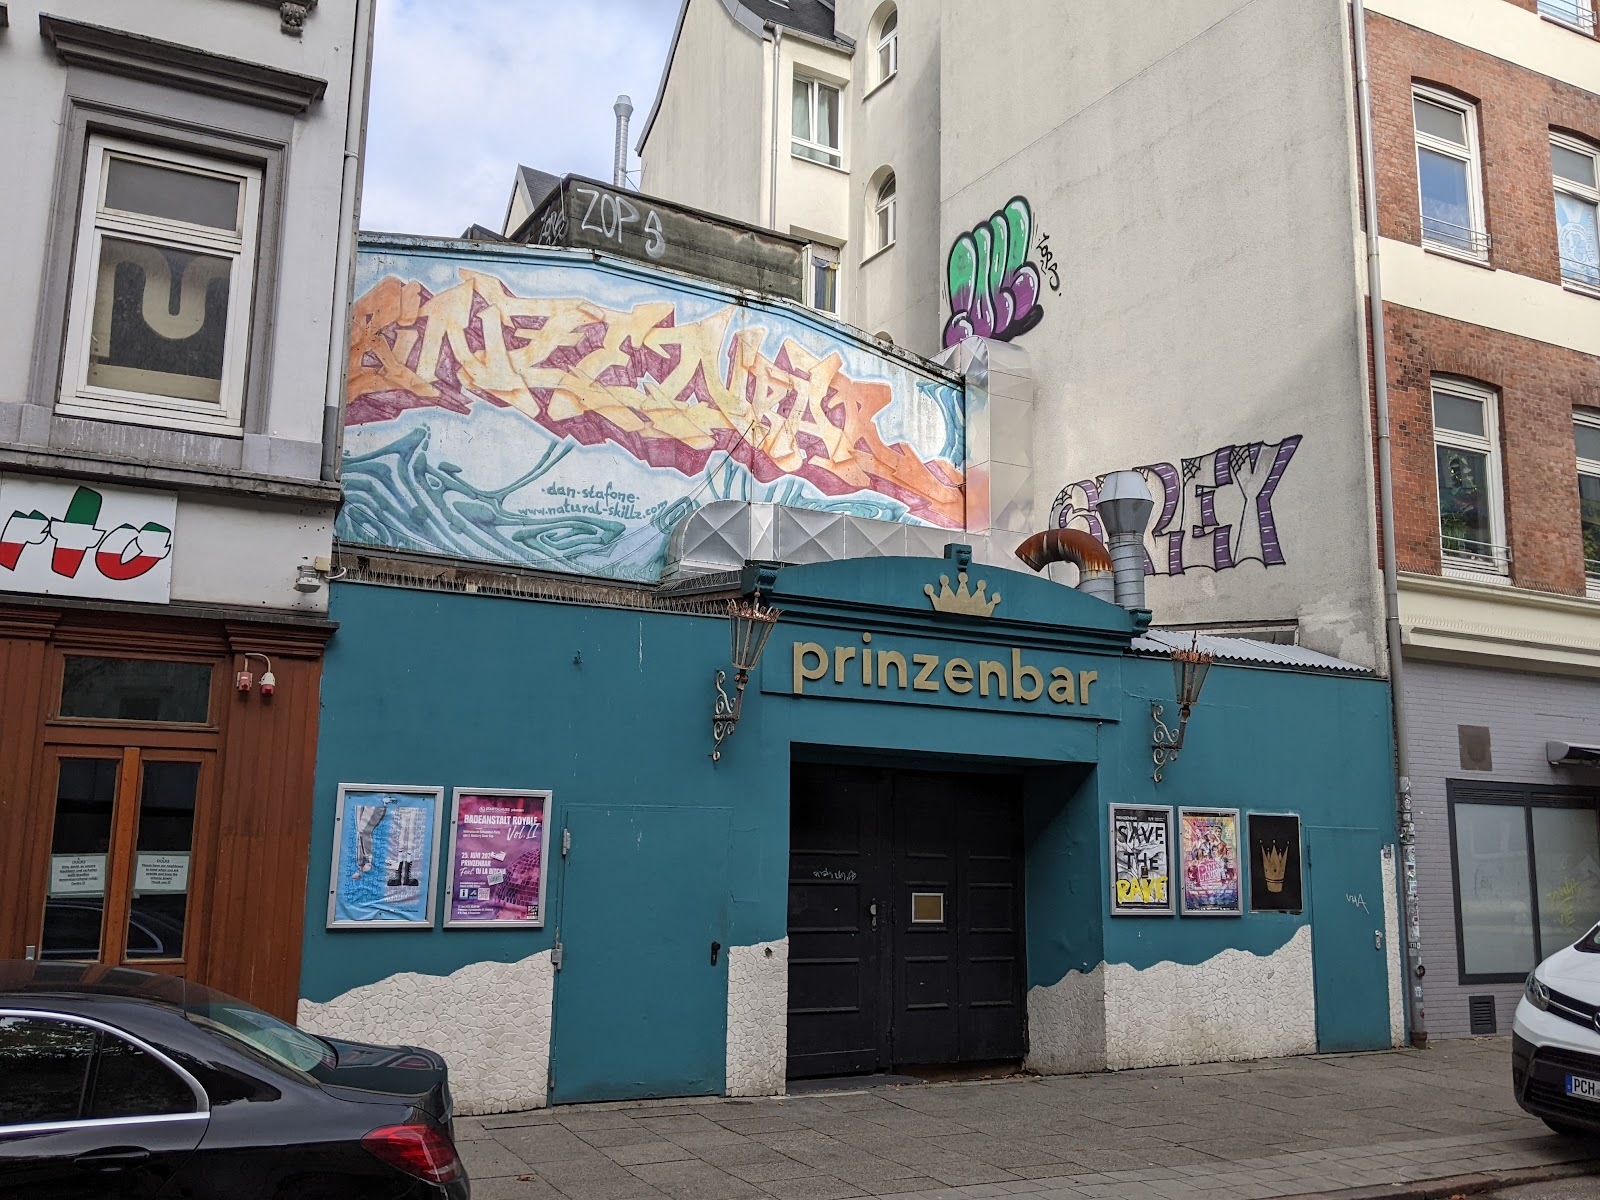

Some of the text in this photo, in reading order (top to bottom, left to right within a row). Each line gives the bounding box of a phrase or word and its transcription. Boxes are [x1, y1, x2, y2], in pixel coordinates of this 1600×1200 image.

[518, 498, 668, 520] www.natural-skillz.com
[793, 632, 1098, 704] prinzenbar
[464, 814, 539, 826] BADEANSTALT ROYALE
[507, 825, 526, 841] Vol.
[1118, 825, 1164, 845] SAVE
[1123, 852, 1160, 871] THE
[1116, 876, 1168, 904] RAVE
[1574, 1078, 1595, 1096] PCH
